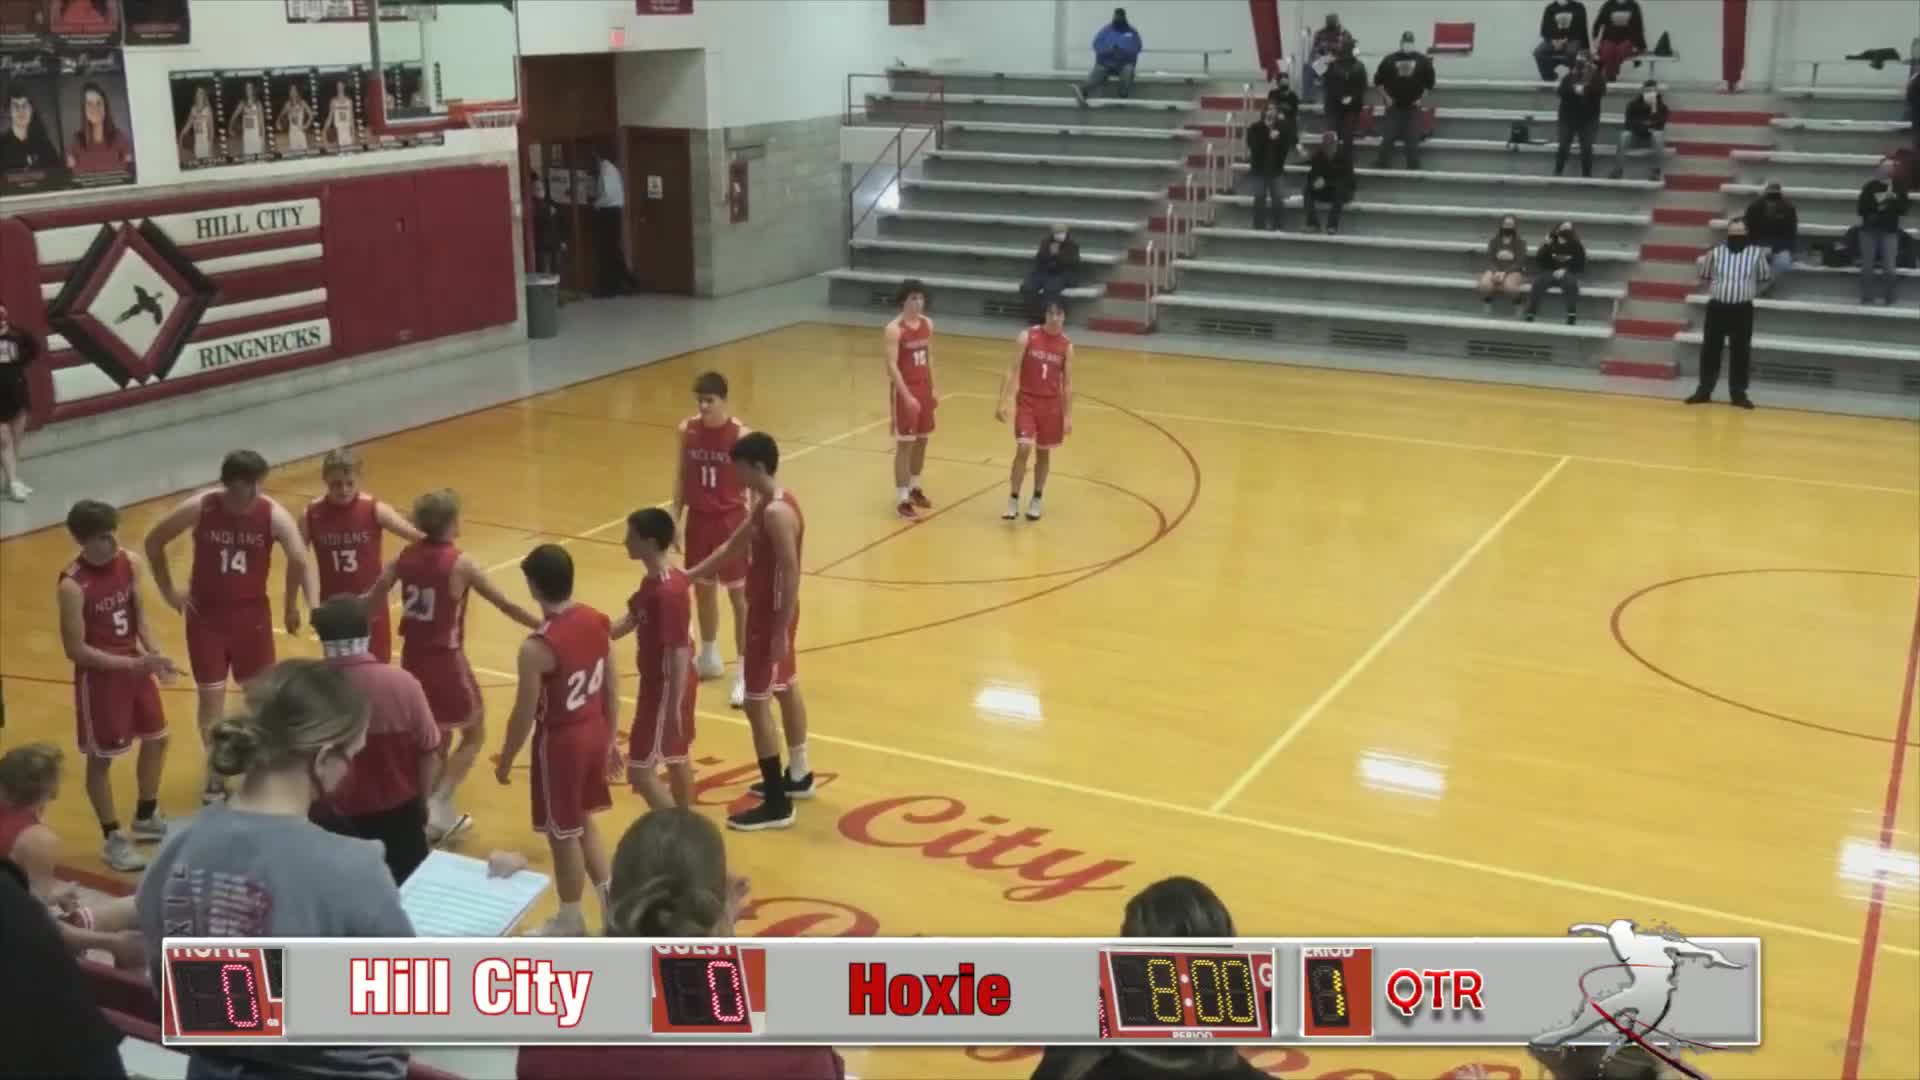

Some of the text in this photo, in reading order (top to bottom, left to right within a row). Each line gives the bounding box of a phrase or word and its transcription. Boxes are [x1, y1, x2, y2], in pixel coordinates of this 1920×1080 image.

[196, 205, 304, 240] HILL CITY
[197, 325, 321, 369] RINGNECKS
[1041, 363, 1048, 380] 1
[701, 465, 717, 488] 11
[219, 549, 247, 575] 14
[331, 550, 359, 573] 13
[112, 609, 129, 636] 5
[566, 657, 605, 711] 24
[837, 795, 1134, 902] City
